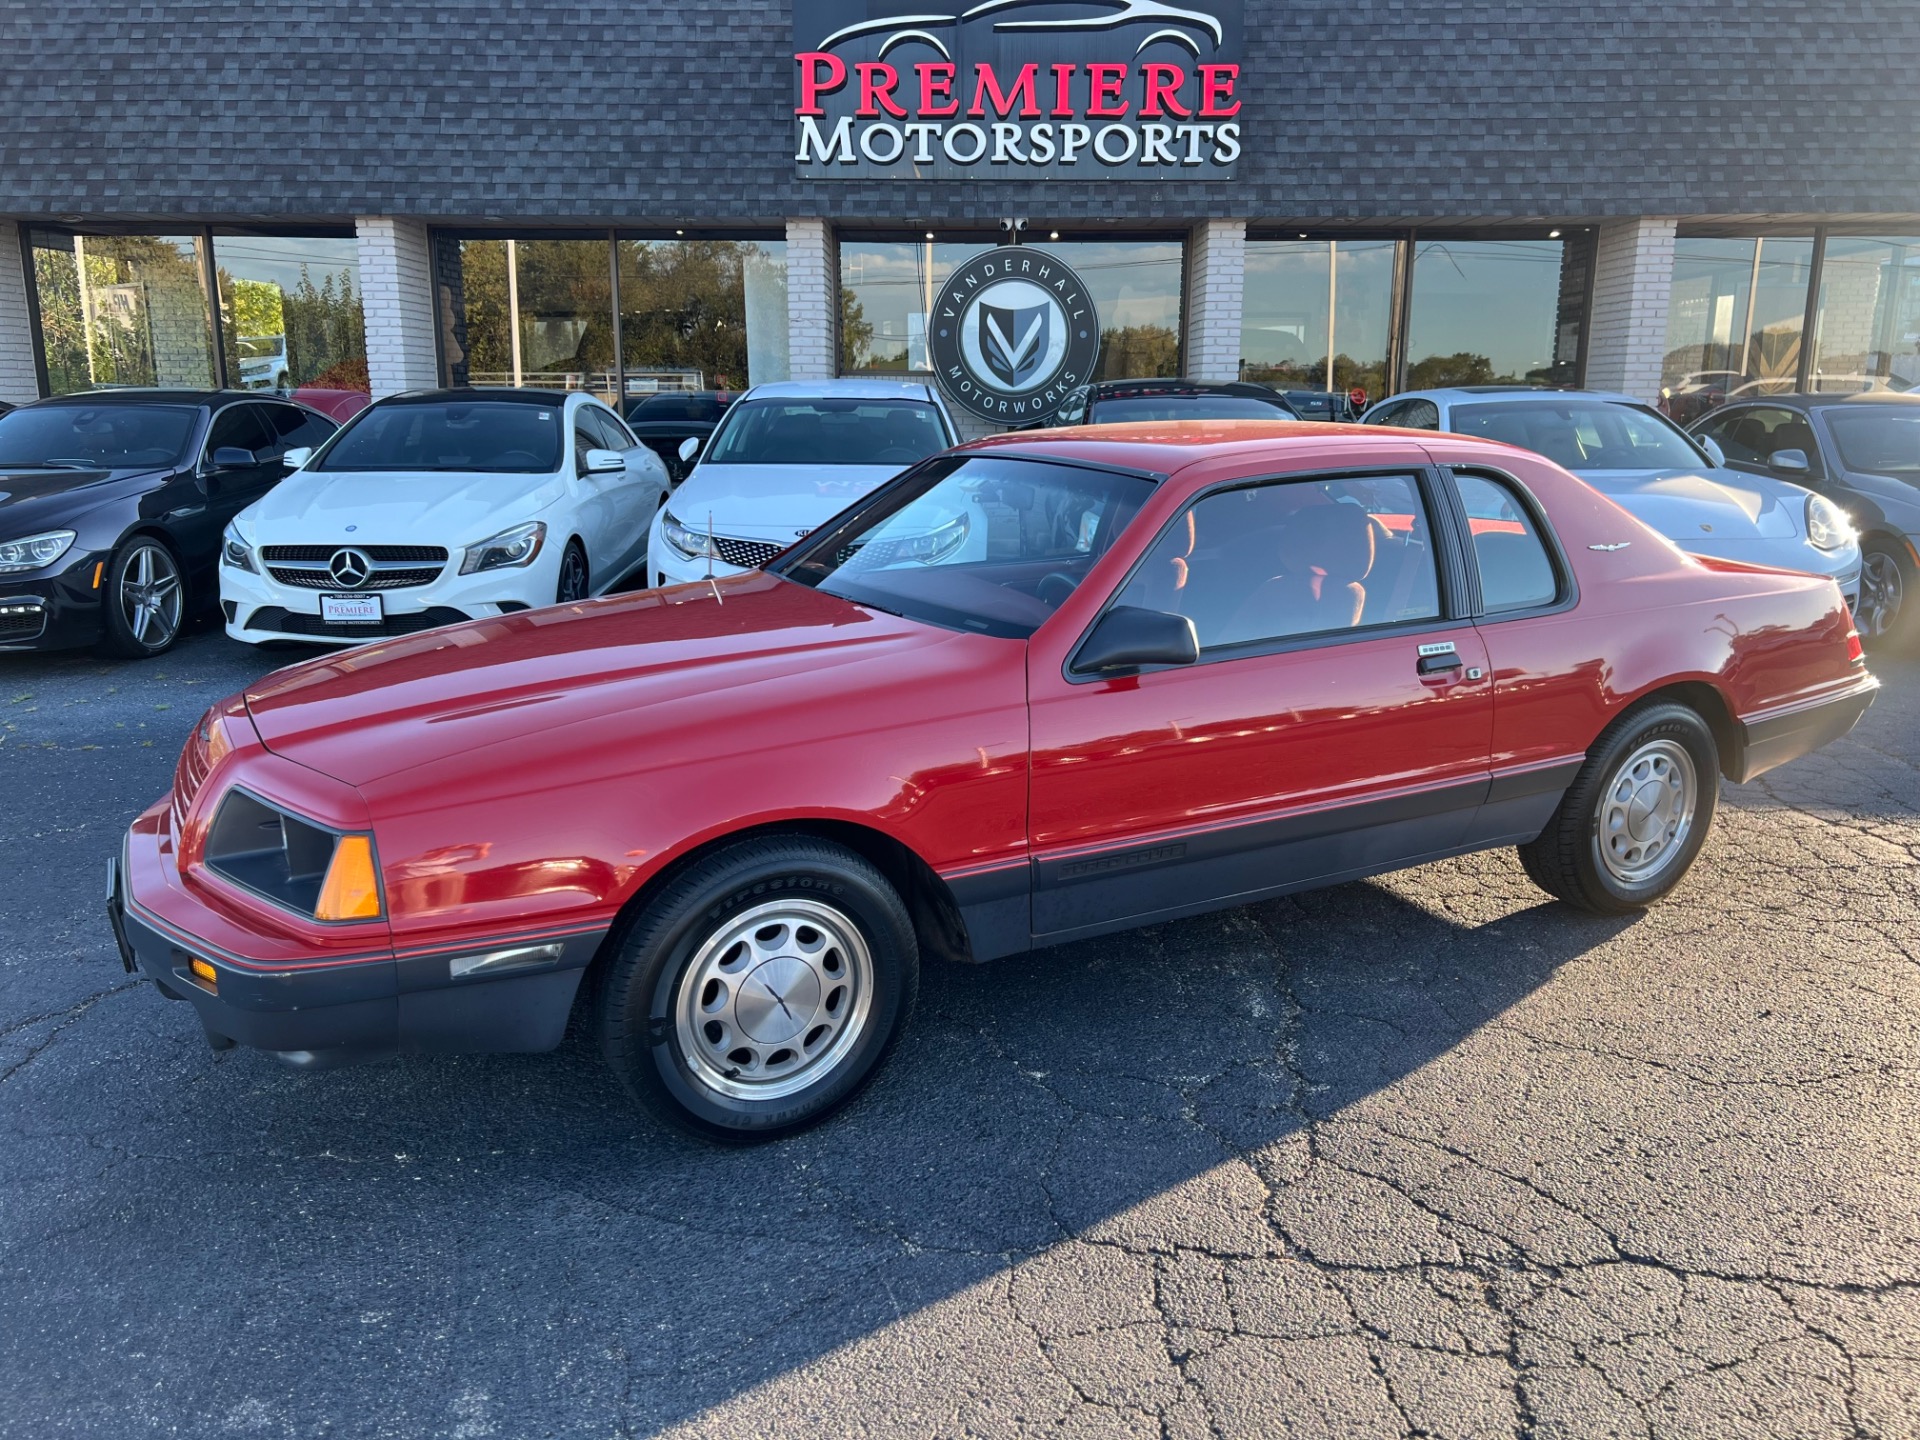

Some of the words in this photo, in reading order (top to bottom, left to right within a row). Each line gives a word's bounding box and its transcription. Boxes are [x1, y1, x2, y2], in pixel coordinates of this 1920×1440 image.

[794, 52, 1242, 117] PREMIERE
[795, 116, 1241, 165] MOTORSPORTS
[943, 260, 1085, 321] VANDERHALL
[948, 364, 1077, 413] MOTORWORKS
[328, 606, 375, 614] PREMIERE
